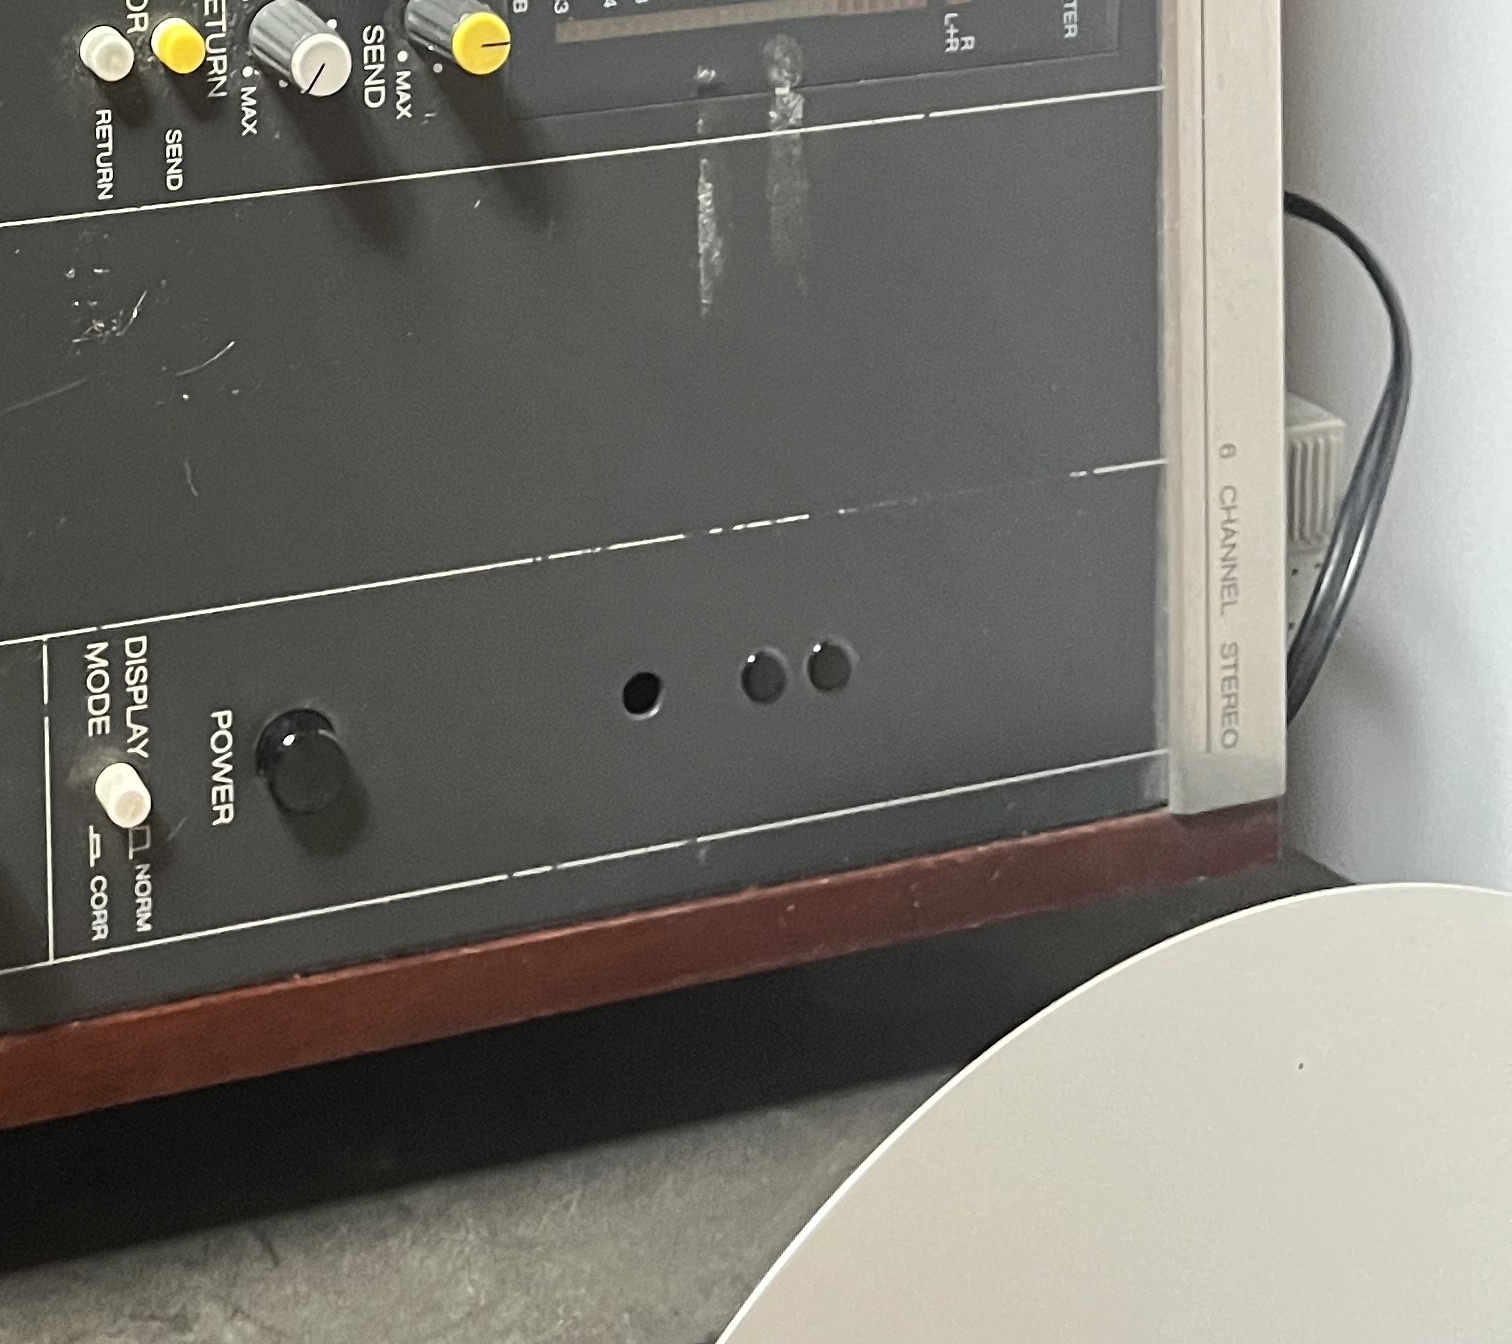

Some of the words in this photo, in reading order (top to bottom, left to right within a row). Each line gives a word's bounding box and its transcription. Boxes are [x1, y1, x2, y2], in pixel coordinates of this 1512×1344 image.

[363, 25, 385, 108] SEND
[945, 13, 959, 52] L+R
[241, 87, 257, 136] MAX
[396, 71, 412, 119] MAX
[96, 110, 113, 200] RETURN
[166, 130, 183, 190] SEND
[1219, 444, 1236, 459] 6
[1220, 486, 1238, 616] CHANNEL
[85, 642, 110, 737] MODE
[125, 636, 148, 758] DISPLAY
[1221, 642, 1239, 749] STEREO
[211, 710, 234, 825] POWER
[91, 876, 108, 940] CORR
[135, 864, 151, 932] NORM
